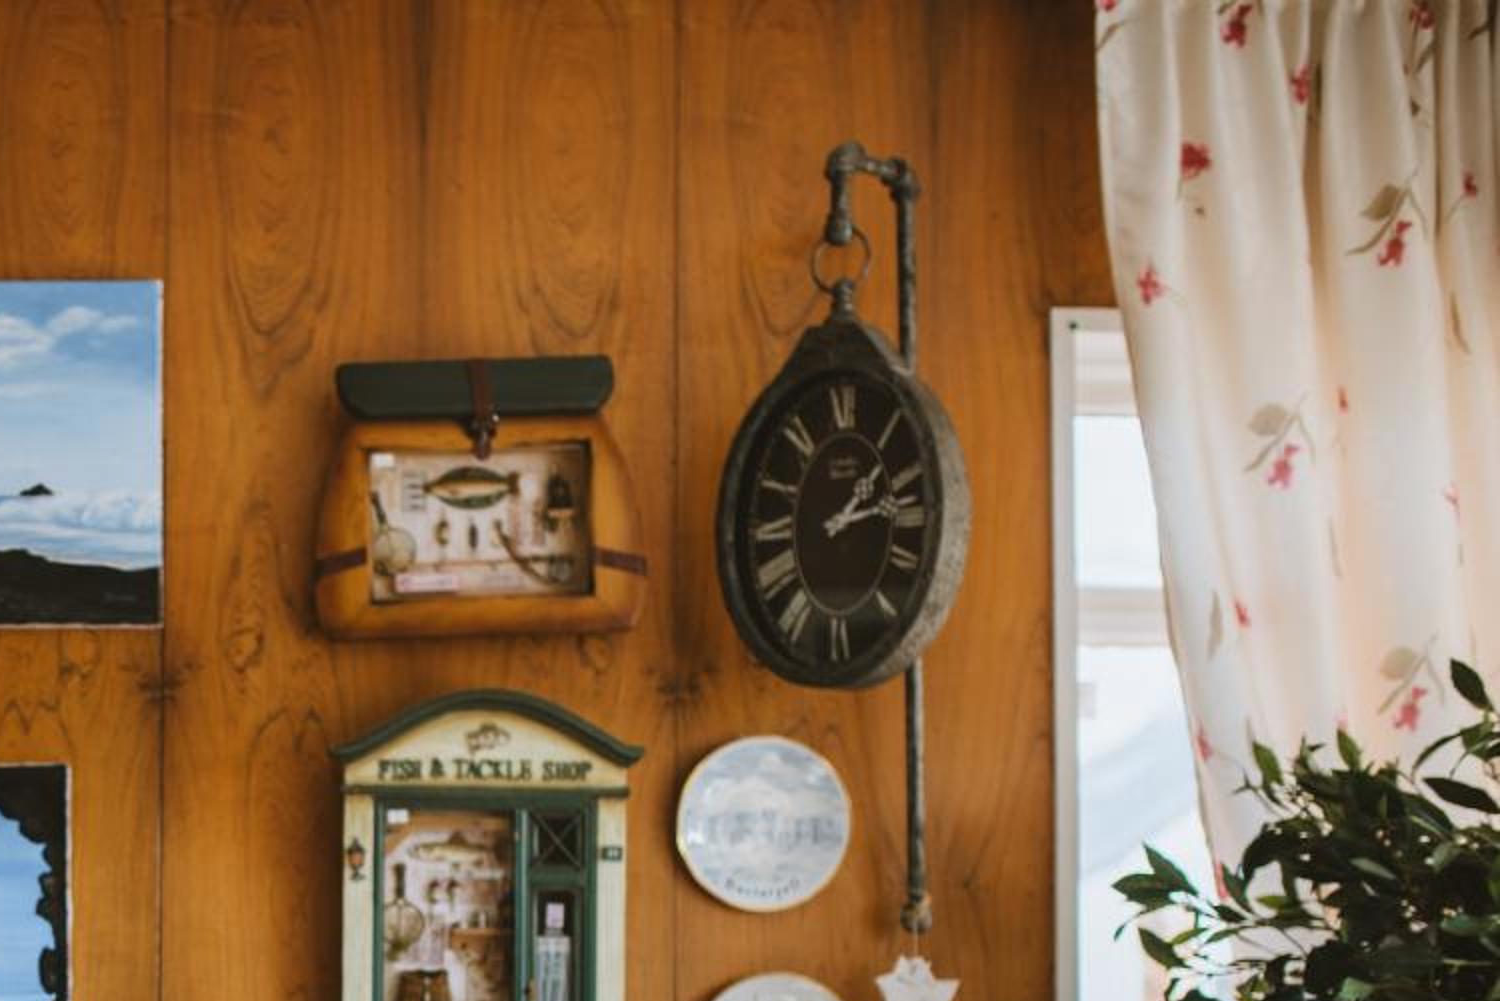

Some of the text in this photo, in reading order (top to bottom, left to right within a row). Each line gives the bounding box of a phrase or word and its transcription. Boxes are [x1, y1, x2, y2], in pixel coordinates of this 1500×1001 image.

[377, 756, 593, 782] FISH & TACKLE SHOP
